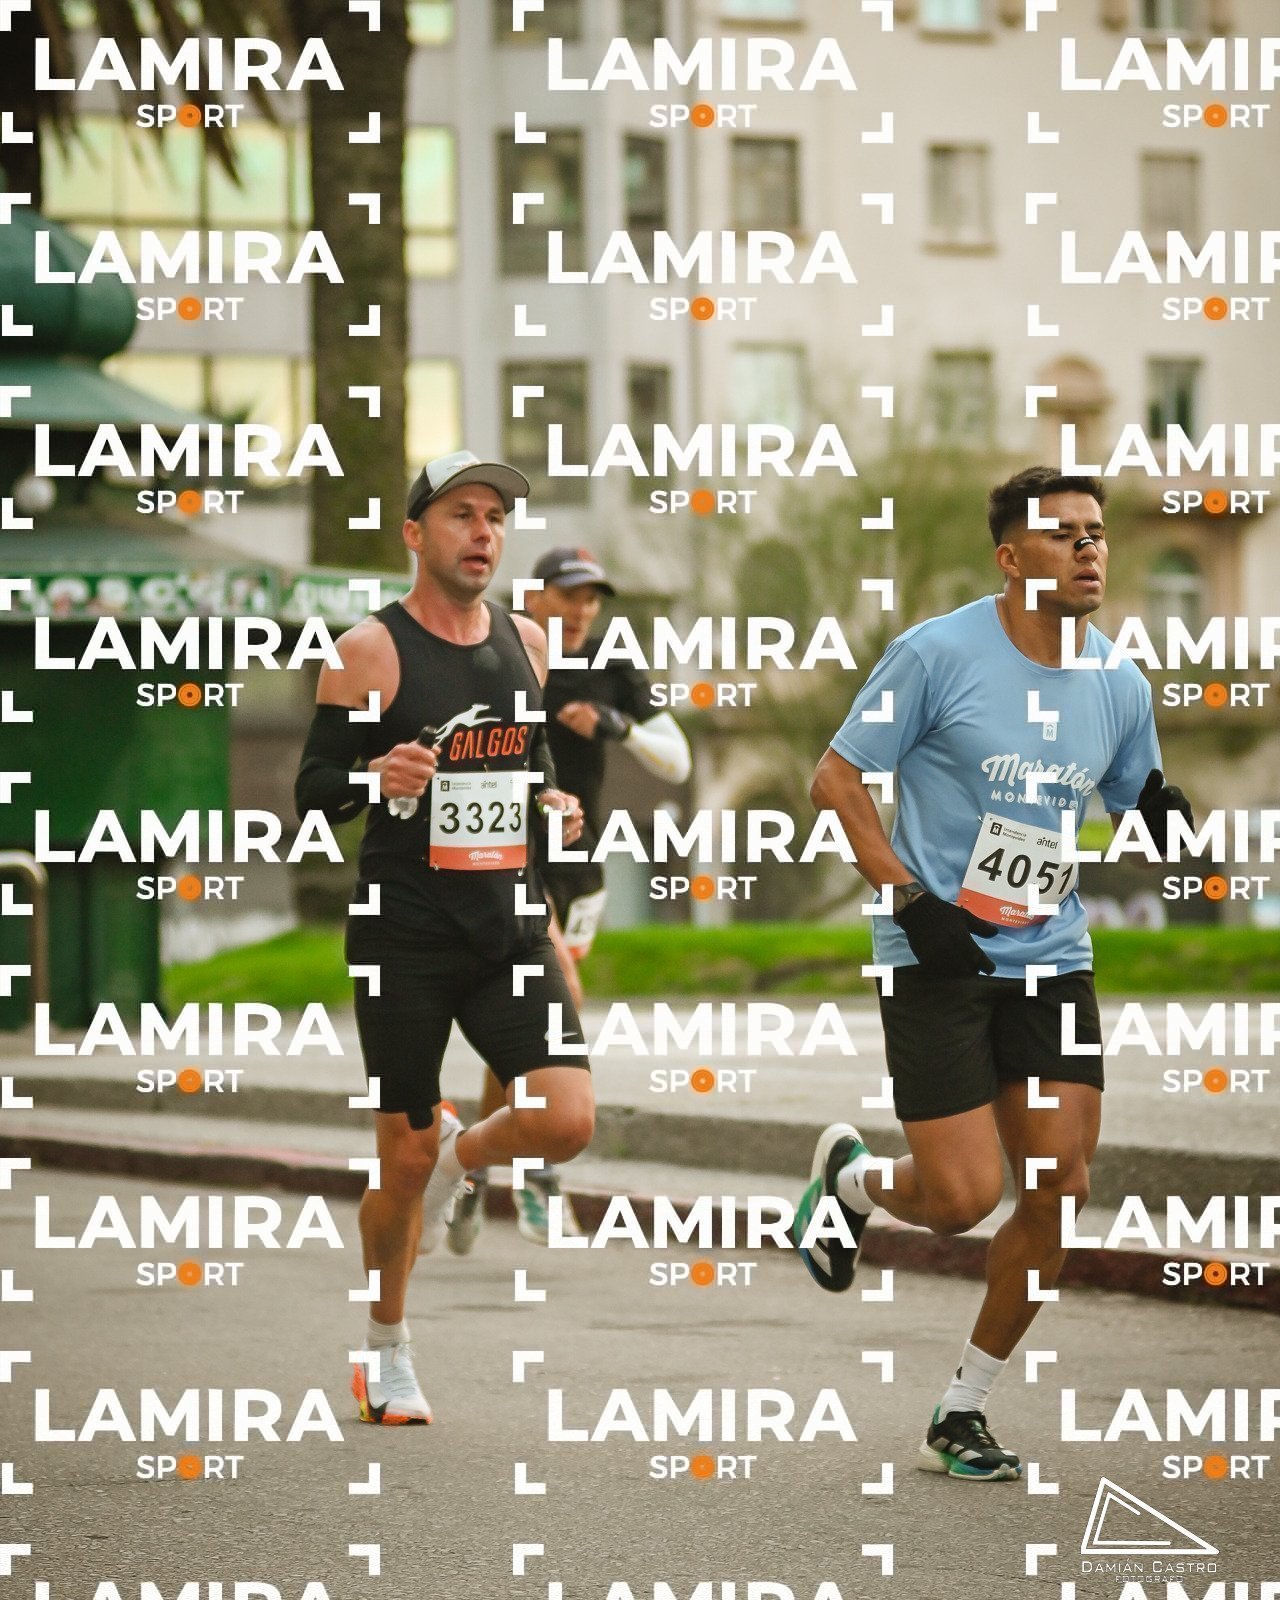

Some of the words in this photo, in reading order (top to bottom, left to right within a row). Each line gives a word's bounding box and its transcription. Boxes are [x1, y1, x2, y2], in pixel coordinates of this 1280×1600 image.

[449, 725, 528, 761] GALGOS
[439, 801, 521, 834] 3323
[1036, 836, 1059, 850] antel
[977, 847, 1073, 895] 4051
